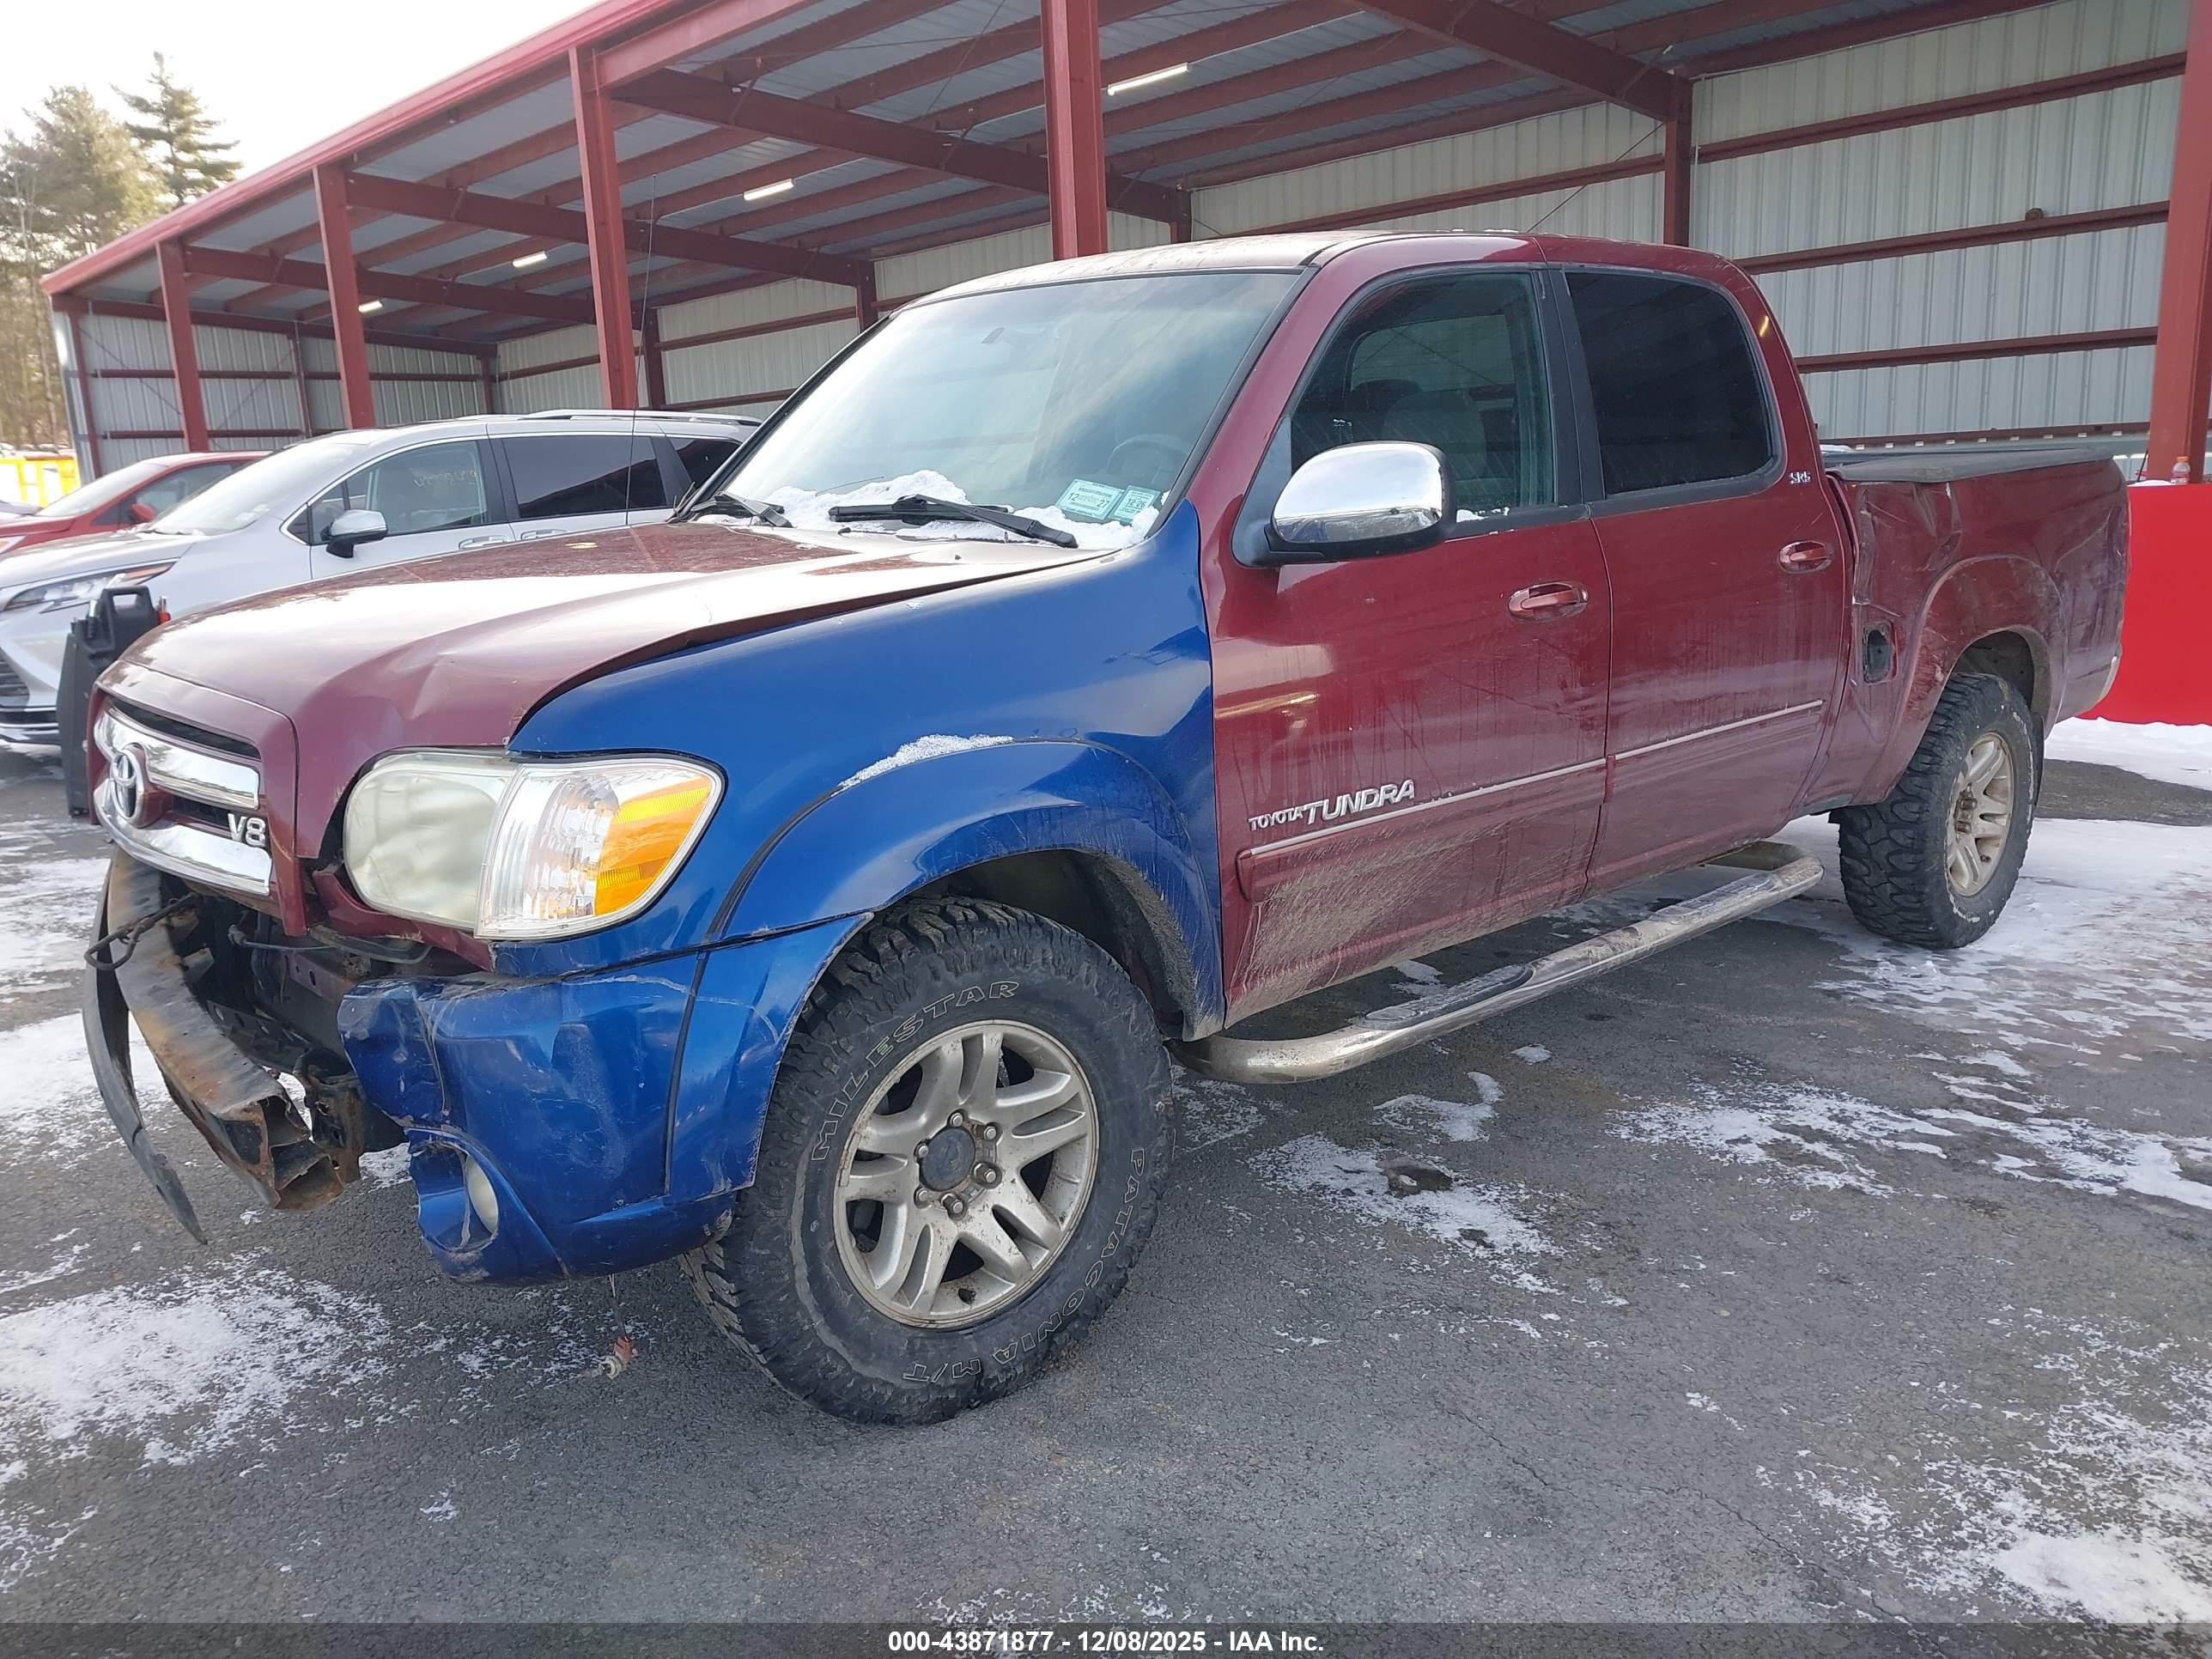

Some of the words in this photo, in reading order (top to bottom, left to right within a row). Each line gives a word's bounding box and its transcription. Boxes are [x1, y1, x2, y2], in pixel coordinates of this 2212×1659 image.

[228, 812, 266, 848] V8
[1248, 806, 1306, 832] TOYOTA
[1303, 779, 1416, 825] TUNDRA
[811, 981, 1020, 1161] MILESTAR
[992, 1148, 1145, 1365] PATAGONIA
[902, 1358, 981, 1382] M/T
